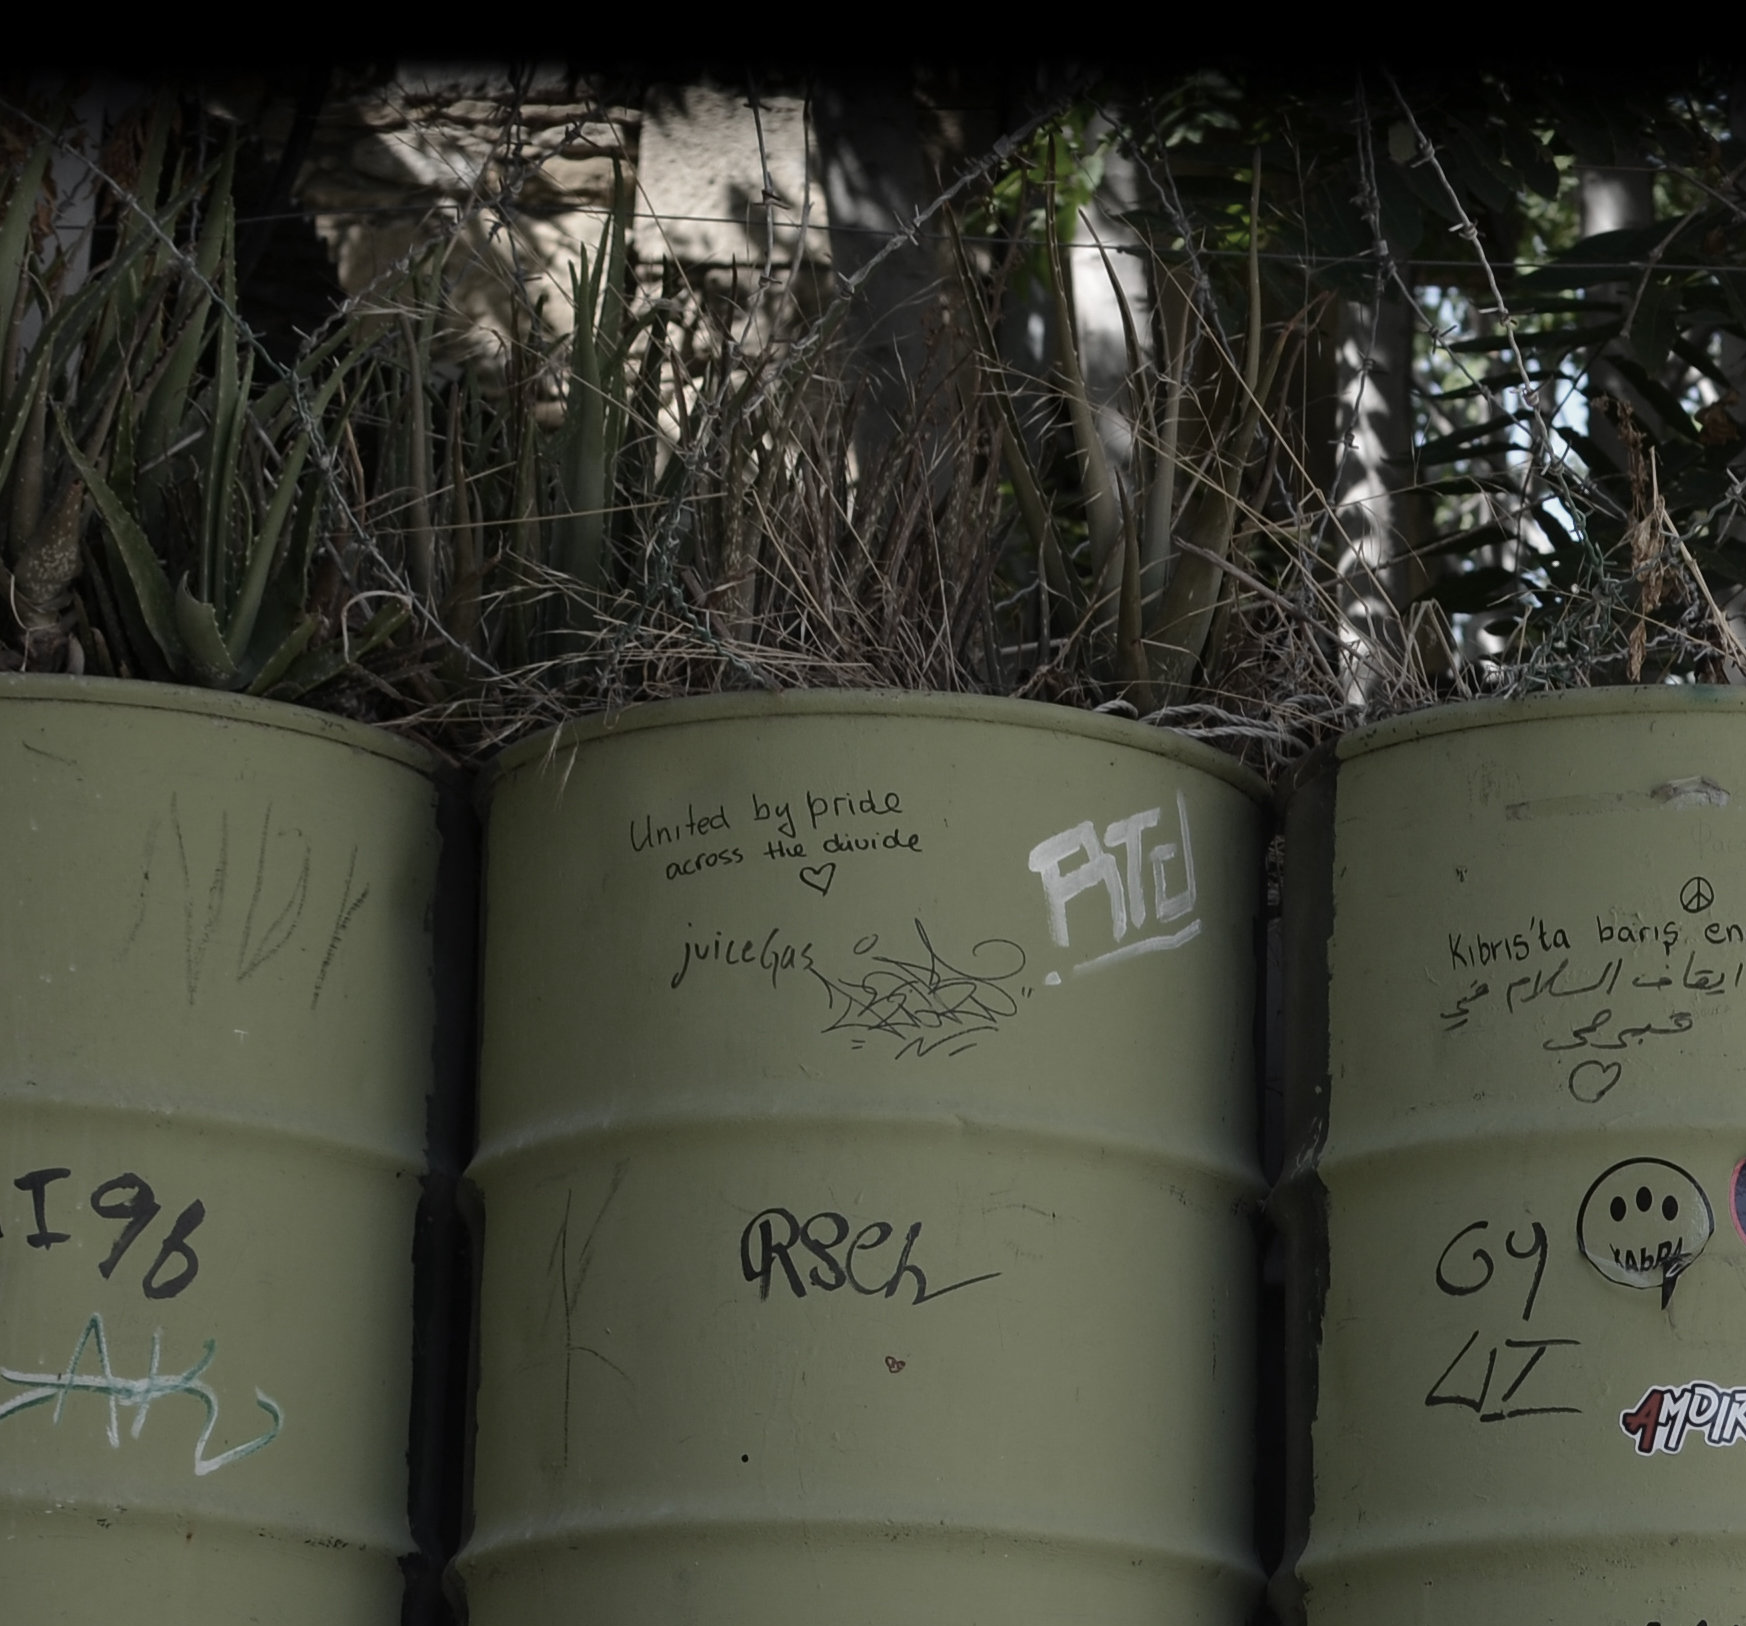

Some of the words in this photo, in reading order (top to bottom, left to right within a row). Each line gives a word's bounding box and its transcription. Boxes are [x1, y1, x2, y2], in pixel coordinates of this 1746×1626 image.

[630, 804, 731, 854] United
[752, 794, 797, 839] by
[806, 790, 904, 837] pride
[665, 847, 745, 881] across
[762, 841, 807, 862] the
[822, 829, 924, 855] divide
